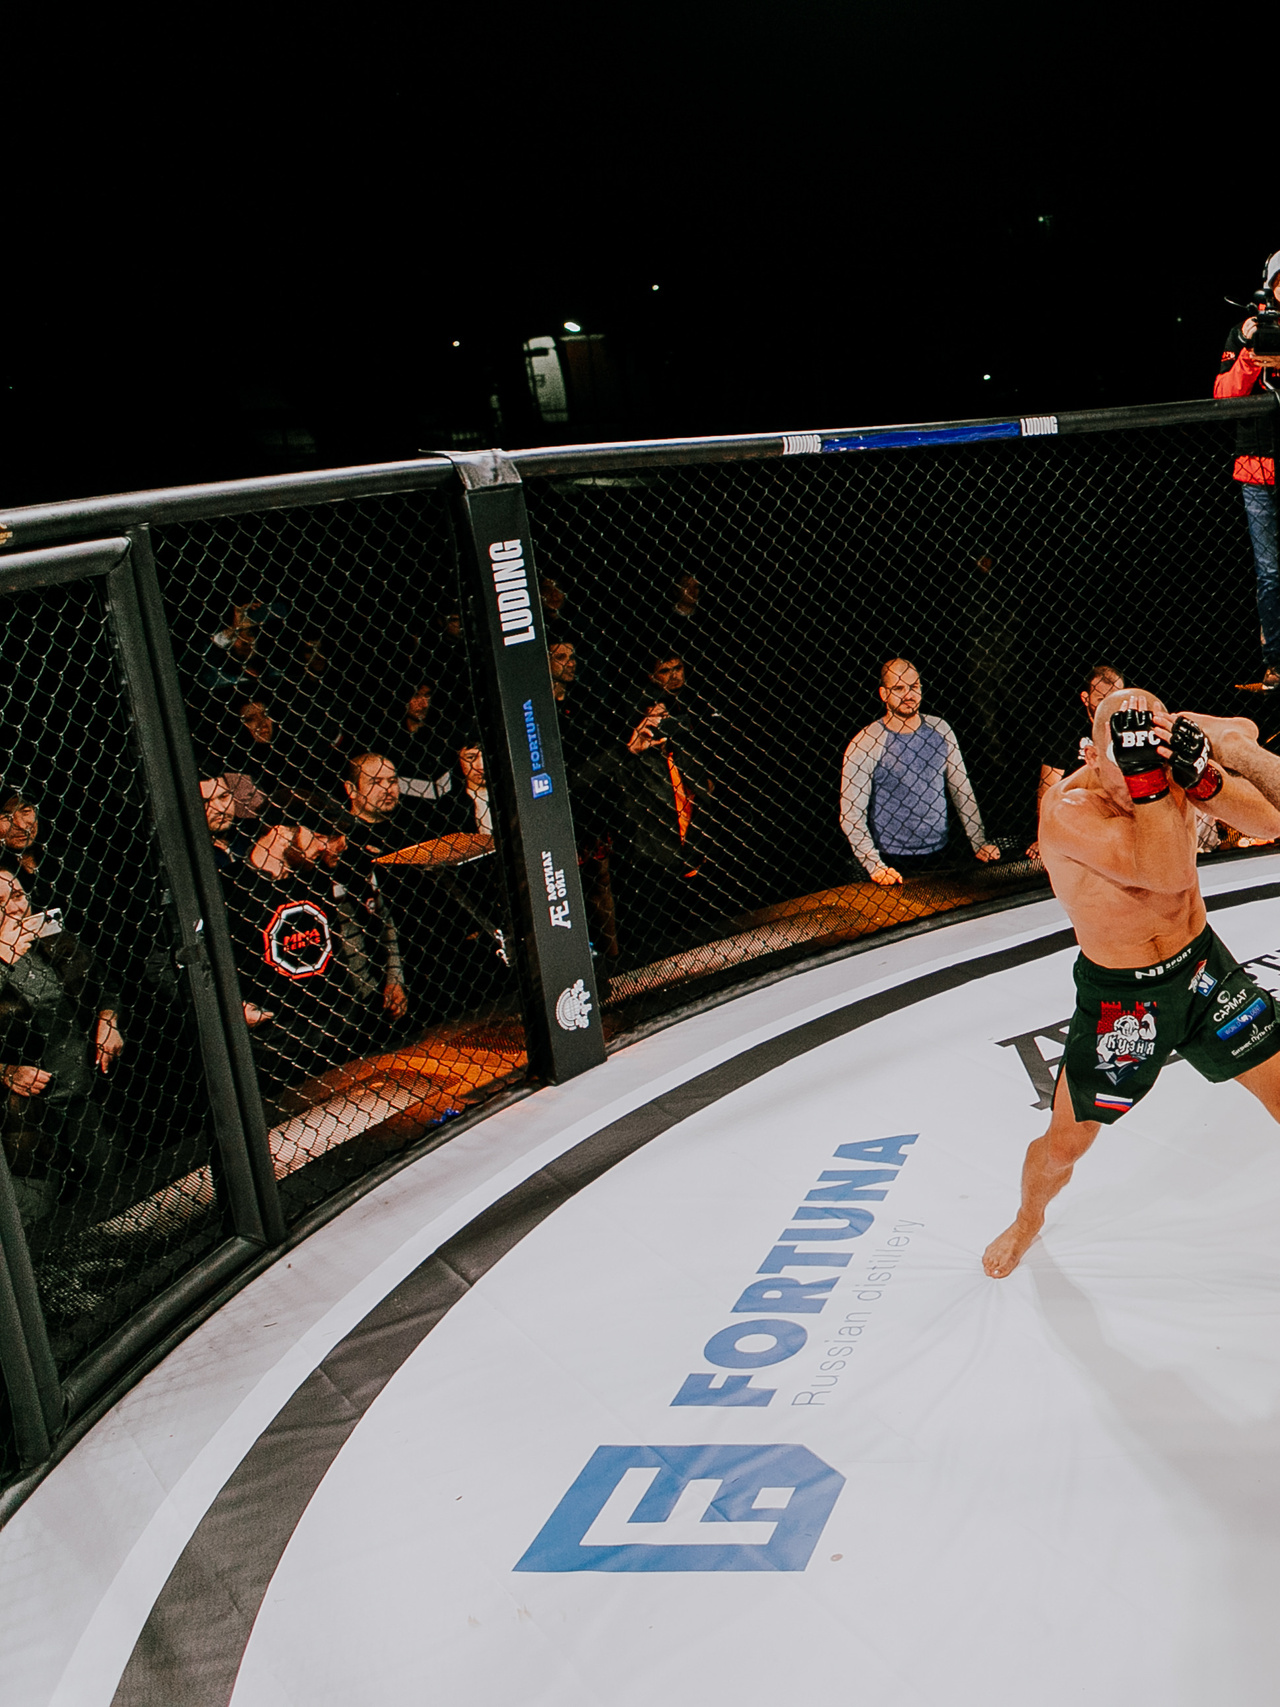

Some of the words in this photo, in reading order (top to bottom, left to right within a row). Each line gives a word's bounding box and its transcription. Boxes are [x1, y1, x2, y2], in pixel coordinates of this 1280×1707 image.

[1020, 416, 1058, 436] LUDING
[489, 539, 536, 646] LUDING
[522, 699, 542, 771] FORTUNA
[1121, 730, 1161, 748] BFC
[1165, 948, 1192, 969] SPORT
[1213, 989, 1247, 1022] САРМАТ
[669, 1133, 920, 1407] FORTUNA
[791, 1311, 873, 1406] Russian
[852, 1218, 926, 1302] distillery
